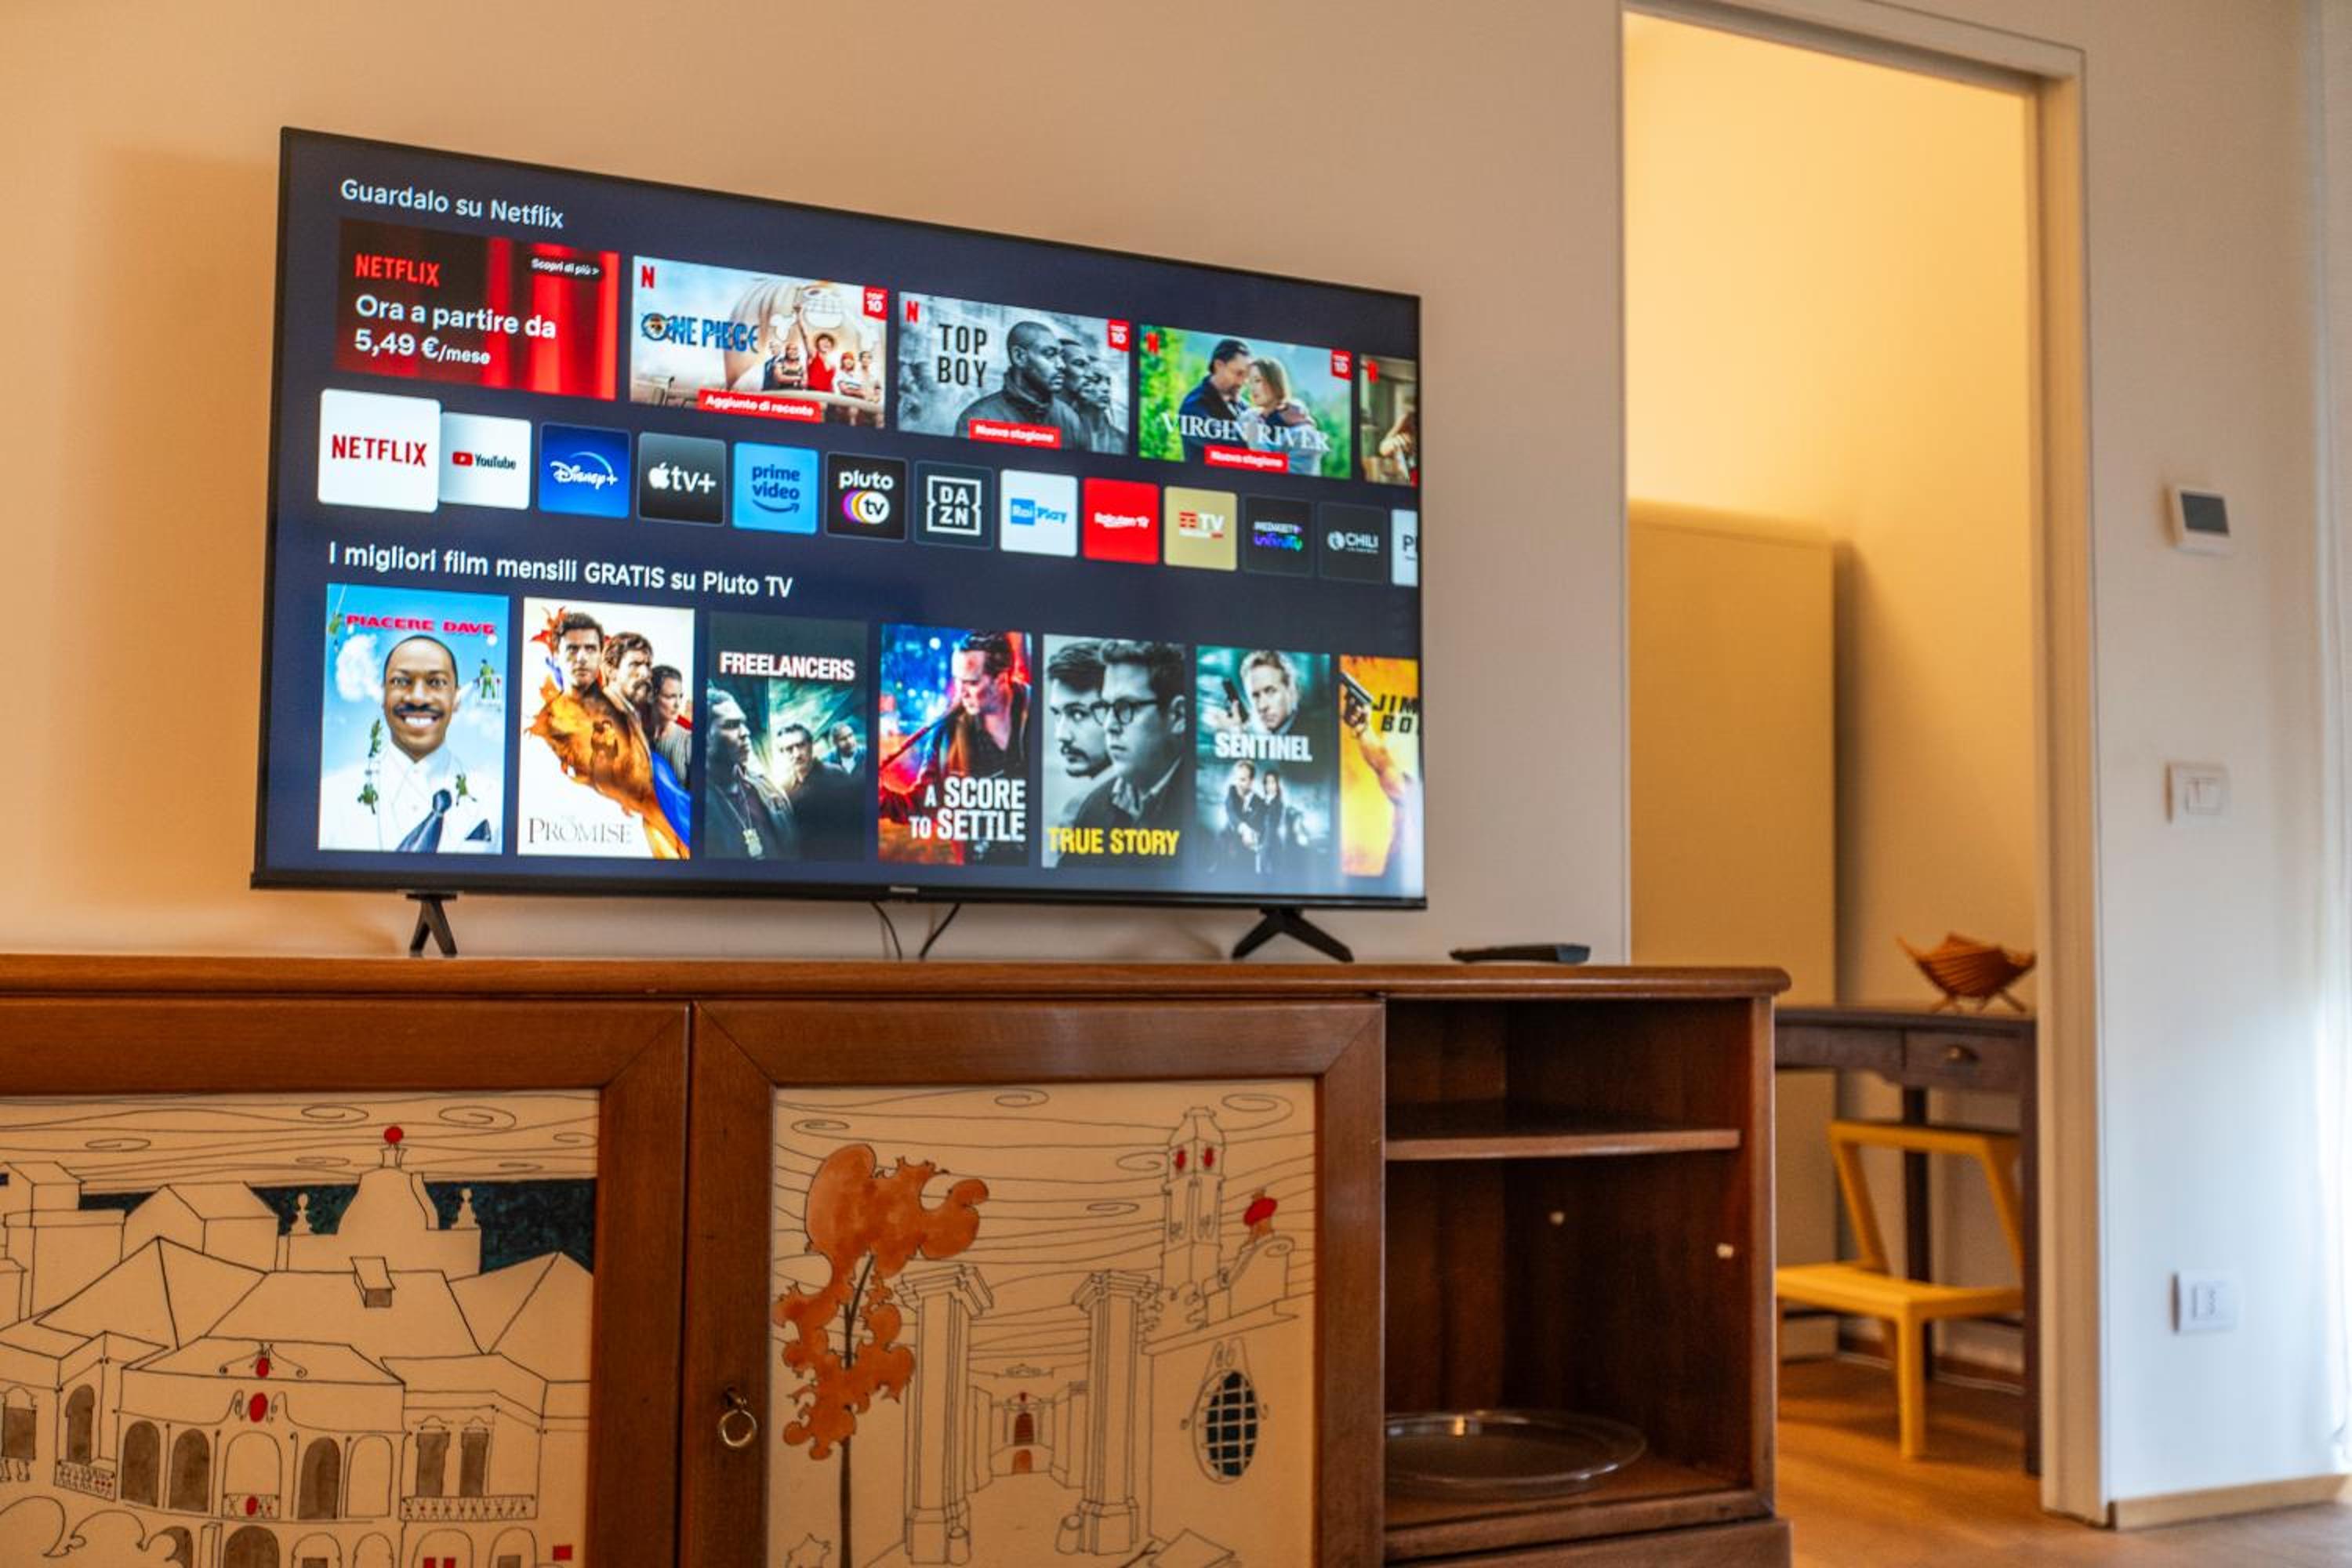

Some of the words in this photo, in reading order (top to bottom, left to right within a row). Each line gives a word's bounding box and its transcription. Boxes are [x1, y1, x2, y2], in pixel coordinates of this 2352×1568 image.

[341, 179, 448, 213] Guardalo
[456, 196, 482, 217] su
[491, 199, 564, 229] Netflix
[355, 253, 440, 288] NETFLIX
[532, 258, 564, 273] Scopri
[641, 265, 655, 289] N
[355, 294, 404, 321] Ora
[411, 304, 426, 323] a
[433, 304, 519, 335] partire
[524, 314, 557, 339] da
[867, 300, 884, 313] 10
[905, 301, 919, 325] N
[354, 328, 416, 358] 5,49
[702, 318, 760, 353] PIECE
[938, 324, 988, 355] TOP
[937, 356, 988, 388] BOY
[706, 394, 758, 412] Aggiunto
[759, 399, 771, 412] di
[772, 403, 815, 418] recente
[332, 434, 427, 468] NETFLIX
[1258, 423, 1331, 453] RIVER
[474, 453, 517, 470] YouTube
[752, 464, 800, 482] prime
[752, 483, 800, 501] video
[838, 470, 894, 491] pluto
[863, 497, 884, 517] tv
[939, 485, 970, 505] DA
[939, 506, 970, 526] ZN
[1199, 513, 1225, 532] TV
[328, 541, 336, 564] I
[344, 544, 437, 573] migliori
[443, 550, 488, 576] film
[496, 557, 577, 583] mensili
[584, 562, 666, 590] GRATIS
[670, 571, 697, 591] su
[702, 571, 759, 597] Pluto
[765, 575, 793, 598] TV
[346, 615, 435, 633] PIACERE
[443, 621, 495, 636] DAVE
[719, 651, 856, 681] FREELANCERS
[1214, 731, 1312, 762] SENTINEL
[924, 785, 937, 808] A
[944, 775, 1026, 810] SCORE
[528, 817, 632, 844] PROMISE
[909, 817, 931, 840] TO
[937, 809, 1026, 842] SETTLE
[1047, 826, 1104, 855] TRUE
[1109, 827, 1180, 857] STORY
